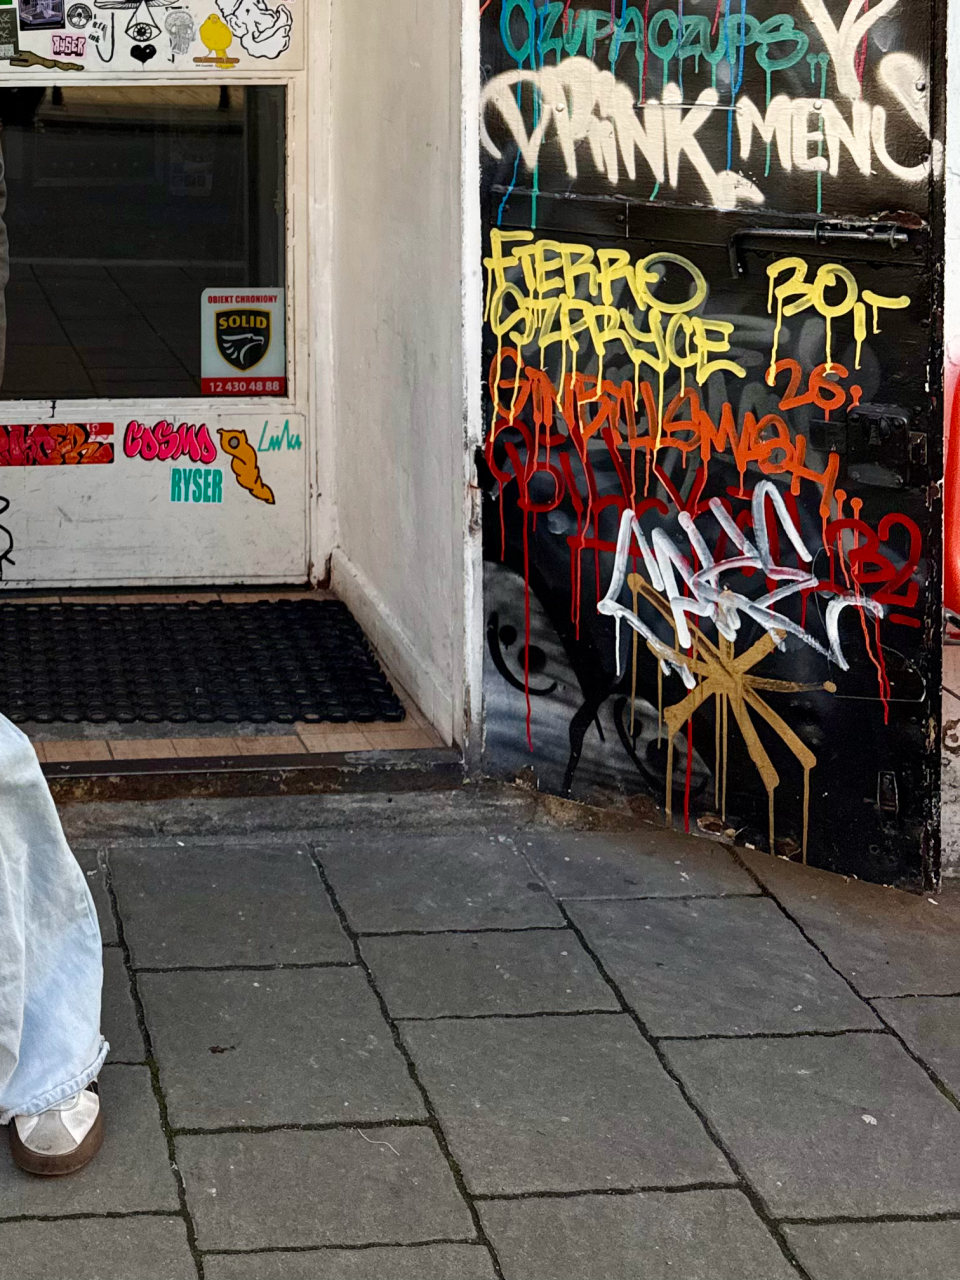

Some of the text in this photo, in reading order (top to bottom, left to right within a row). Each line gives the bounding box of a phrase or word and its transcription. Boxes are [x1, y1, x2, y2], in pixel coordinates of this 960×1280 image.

[208, 295, 278, 304] OBIEKT CHRONIONY
[218, 315, 267, 330] SOLID
[210, 381, 279, 392] 12 430 48 88
[124, 420, 218, 464] COSMO
[171, 468, 223, 503] RYSER
